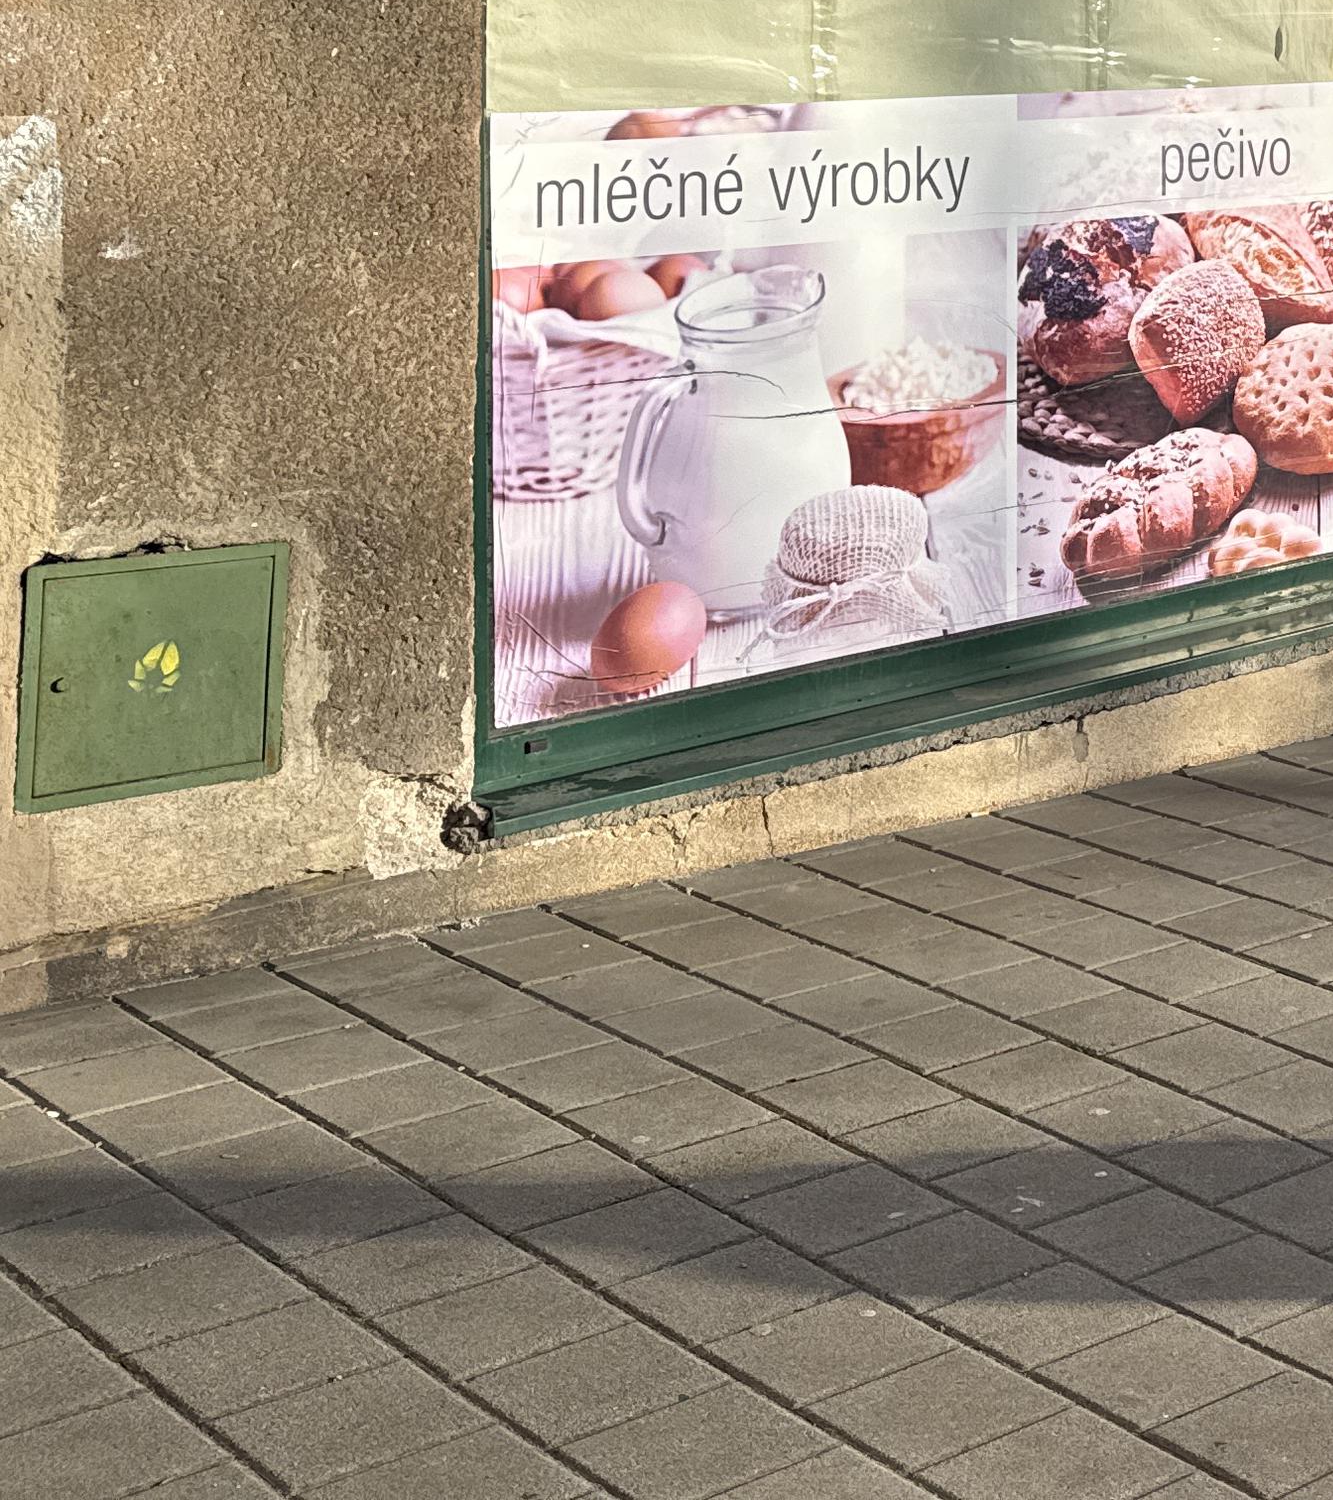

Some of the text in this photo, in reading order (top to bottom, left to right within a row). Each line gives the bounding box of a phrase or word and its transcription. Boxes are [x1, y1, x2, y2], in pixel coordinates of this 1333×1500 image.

[536, 127, 1293, 229] mléčné výrobky pečivo
